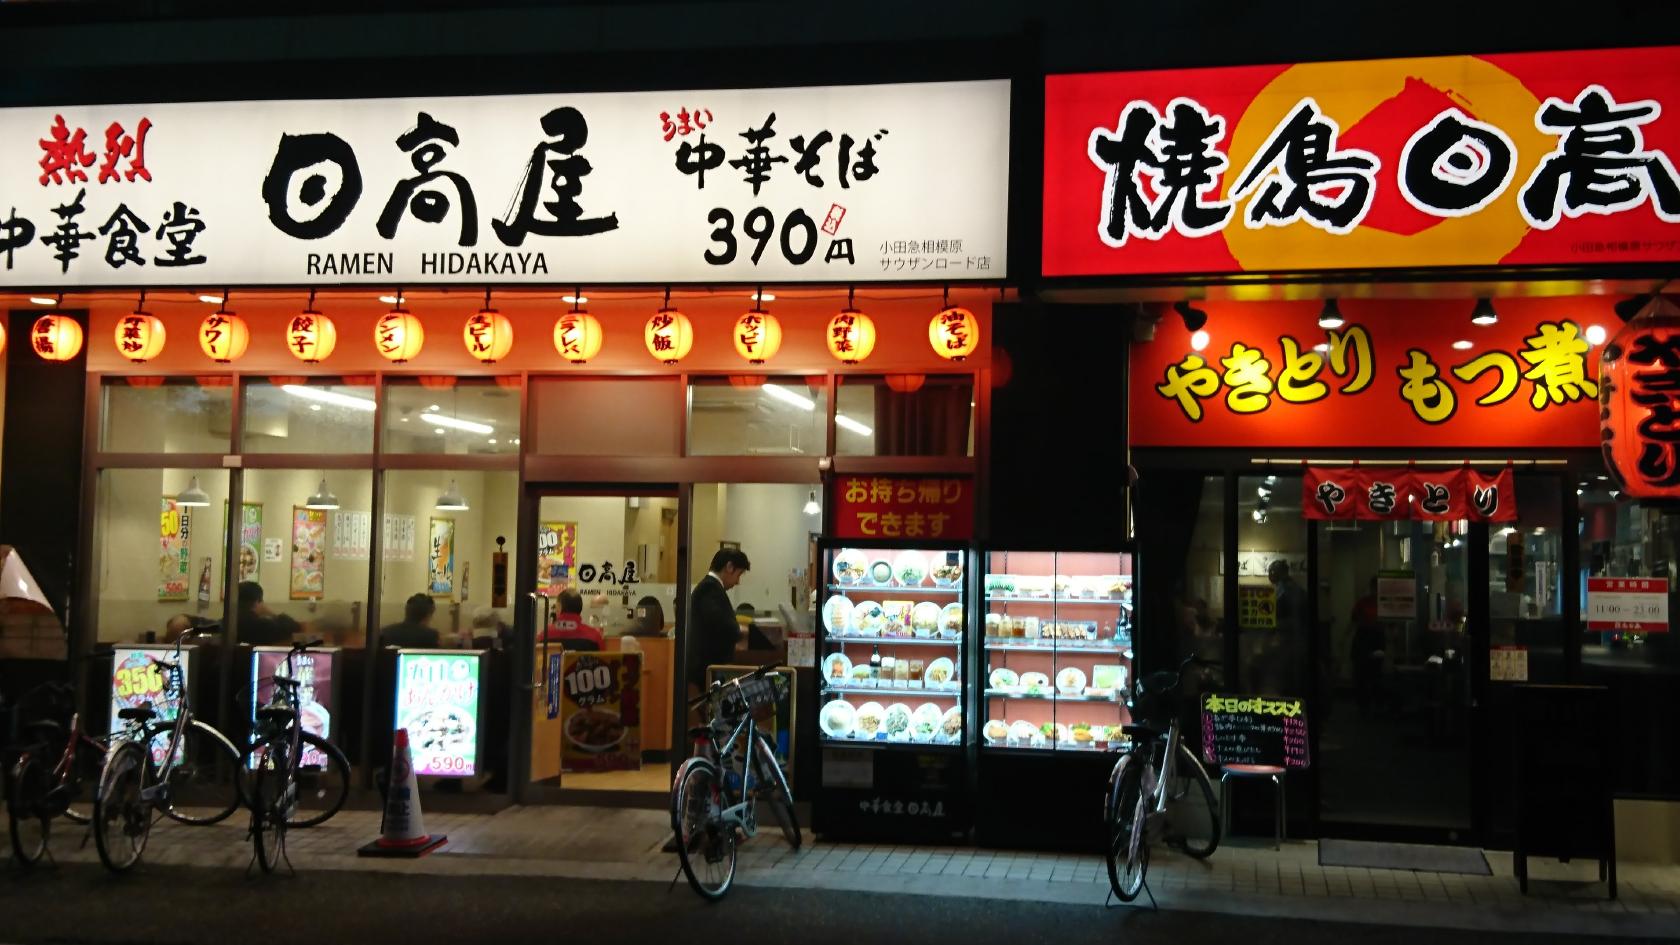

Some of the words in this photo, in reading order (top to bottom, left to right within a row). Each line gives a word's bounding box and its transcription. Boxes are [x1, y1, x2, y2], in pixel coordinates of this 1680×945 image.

[660, 107, 714, 142] うまい
[38, 114, 153, 187] 熱烈
[675, 112, 890, 197] 中華そば
[262, 105, 619, 247] 日高屋
[0, 188, 208, 274] 中華食堂
[703, 206, 856, 266] 390円
[879, 239, 963, 255] 小田急相模原
[307, 252, 394, 275] RAMEN
[421, 252, 548, 275] HIDAKAYA
[879, 255, 991, 272] サウザンロード店
[204, 315, 229, 354] サワー
[291, 315, 315, 354] 餃子
[651, 314, 675, 351] 炒飯
[740, 314, 761, 353] ホッピー
[941, 311, 968, 351] 油そば
[1156, 322, 1375, 422] やきとり
[1400, 321, 1600, 424] もつ煮
[845, 477, 962, 504] お持ち帰り
[1315, 480, 1499, 516] やきとり
[856, 511, 951, 537] できます
[578, 560, 640, 585] 日高屋
[564, 665, 611, 695] 100
[1205, 694, 1302, 717] 本日のオススメ
